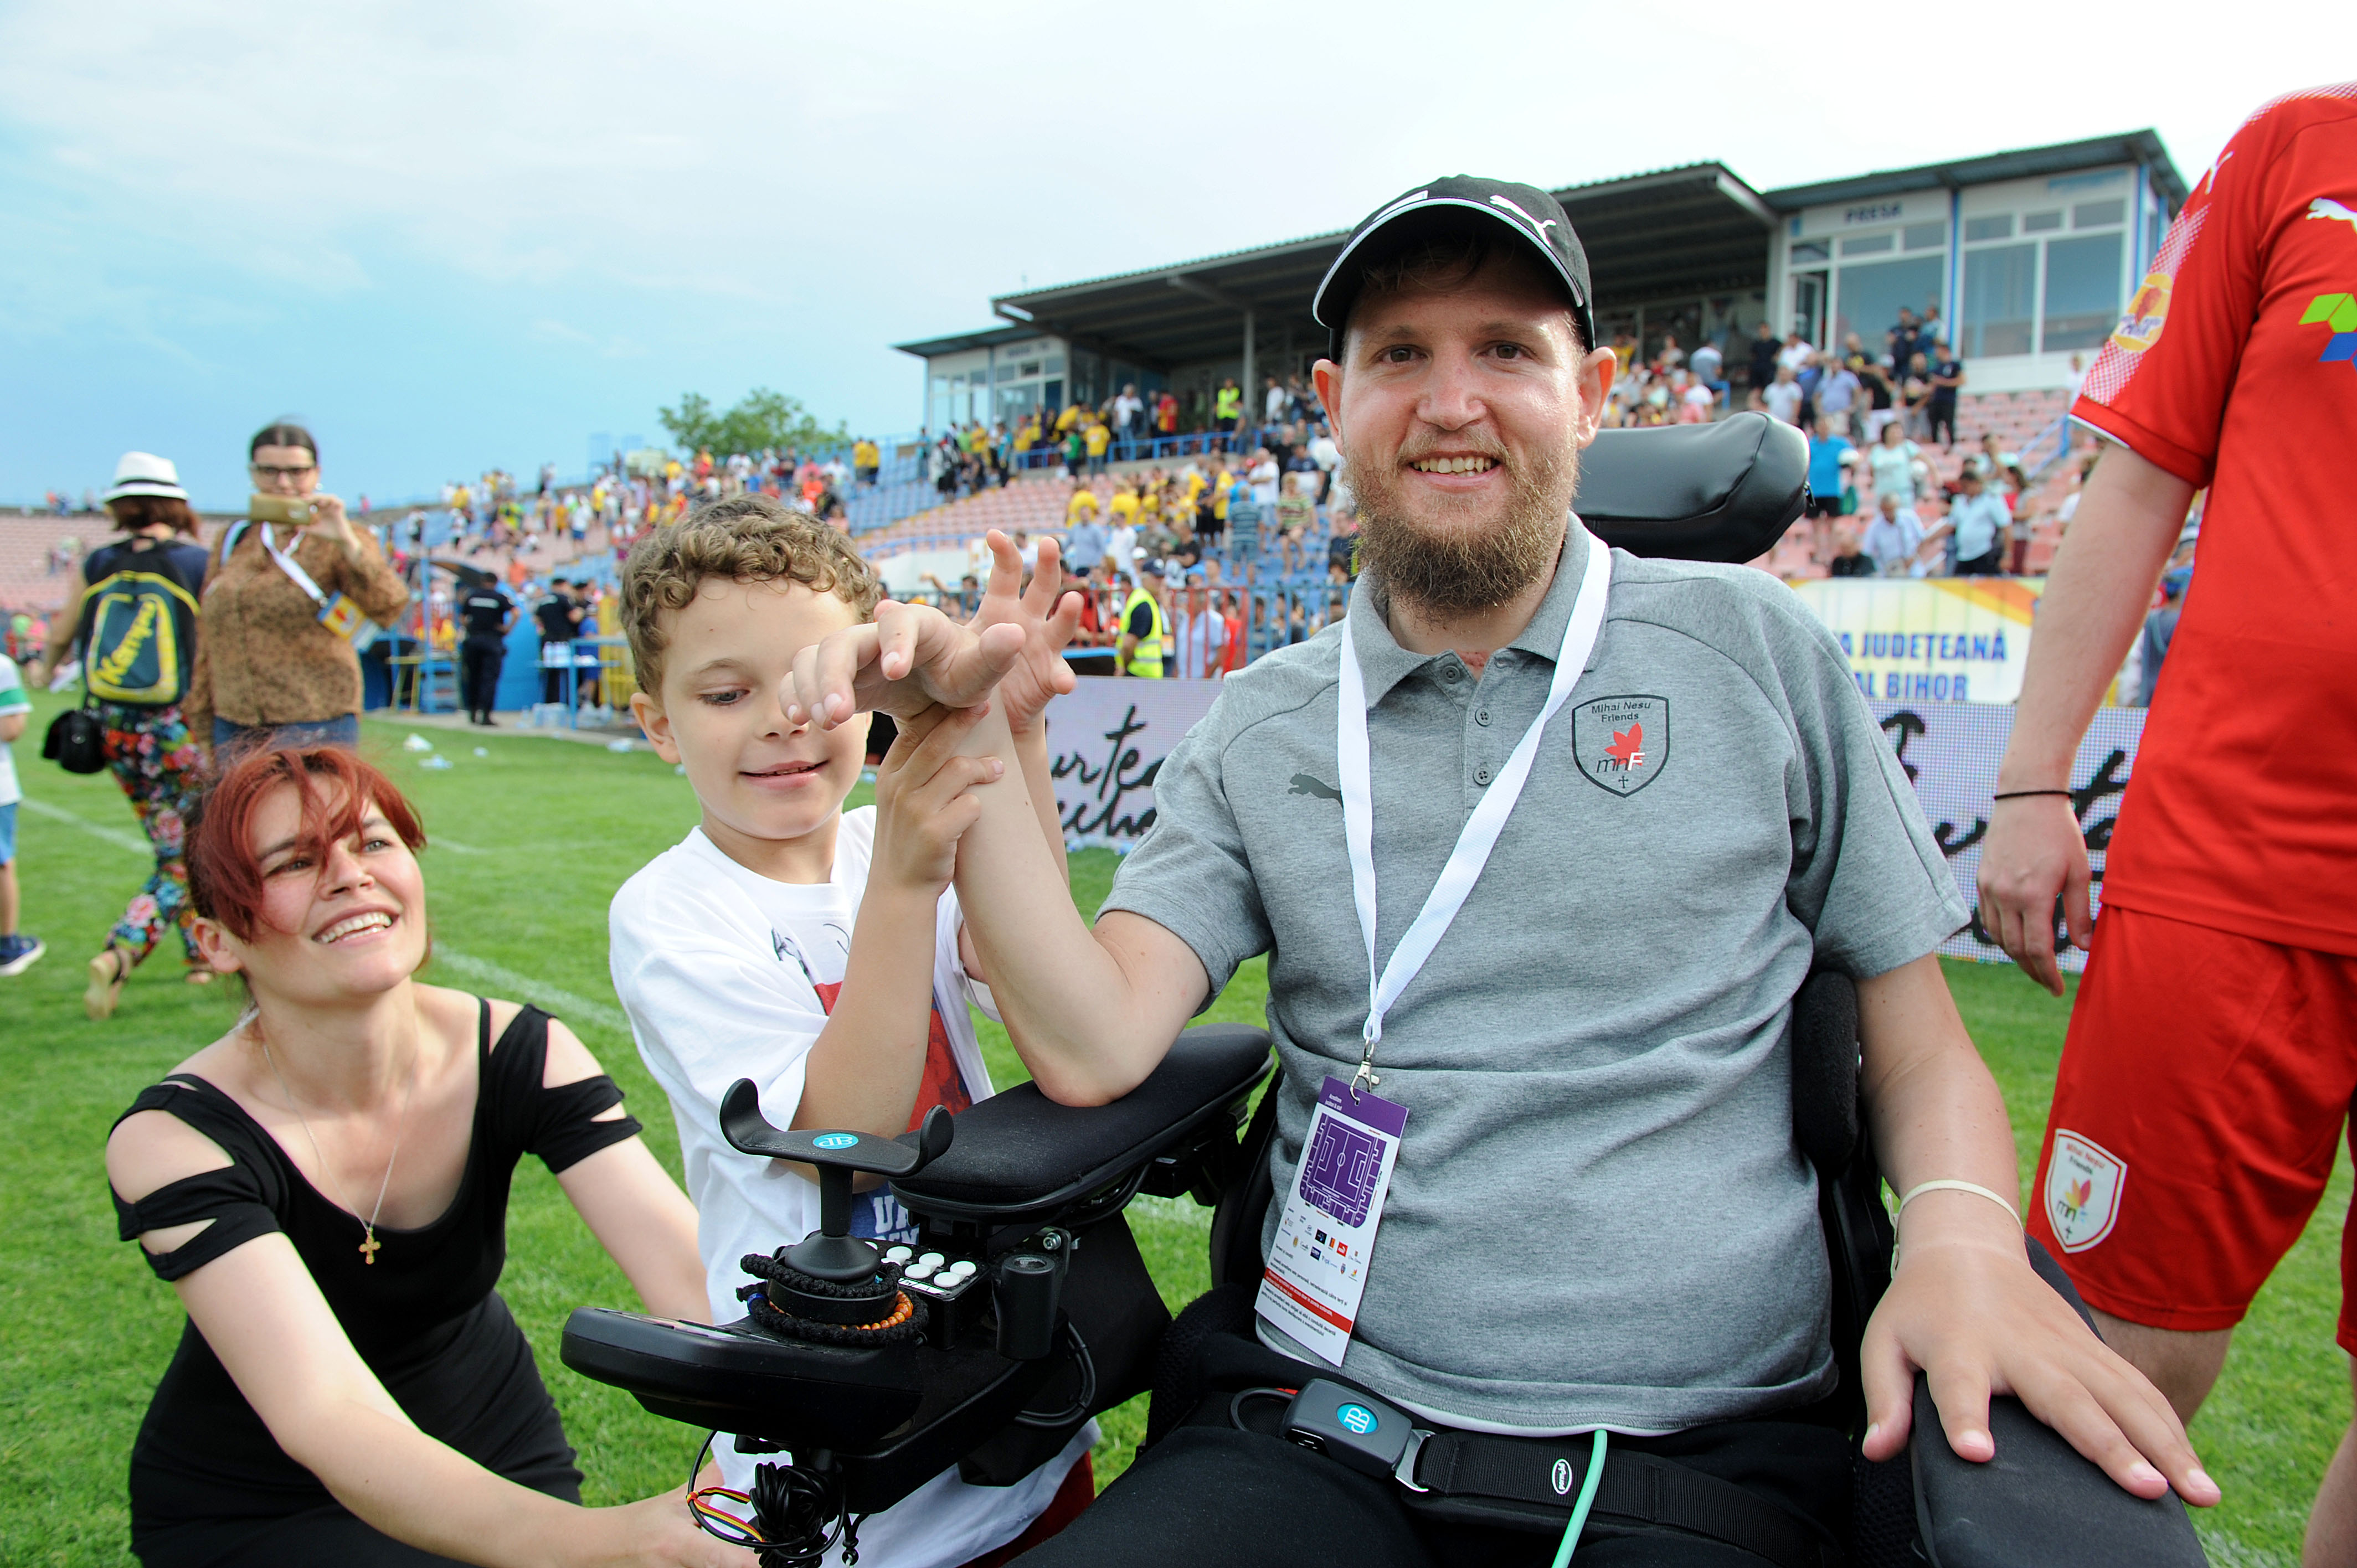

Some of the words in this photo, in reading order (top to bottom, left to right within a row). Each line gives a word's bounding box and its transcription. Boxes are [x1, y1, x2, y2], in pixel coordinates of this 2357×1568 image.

[96, 601, 157, 685] Kempa
[1887, 672, 1968, 701] BIHOR
[1592, 702, 1620, 714] Mihai
[1601, 712, 1639, 723] Friends
